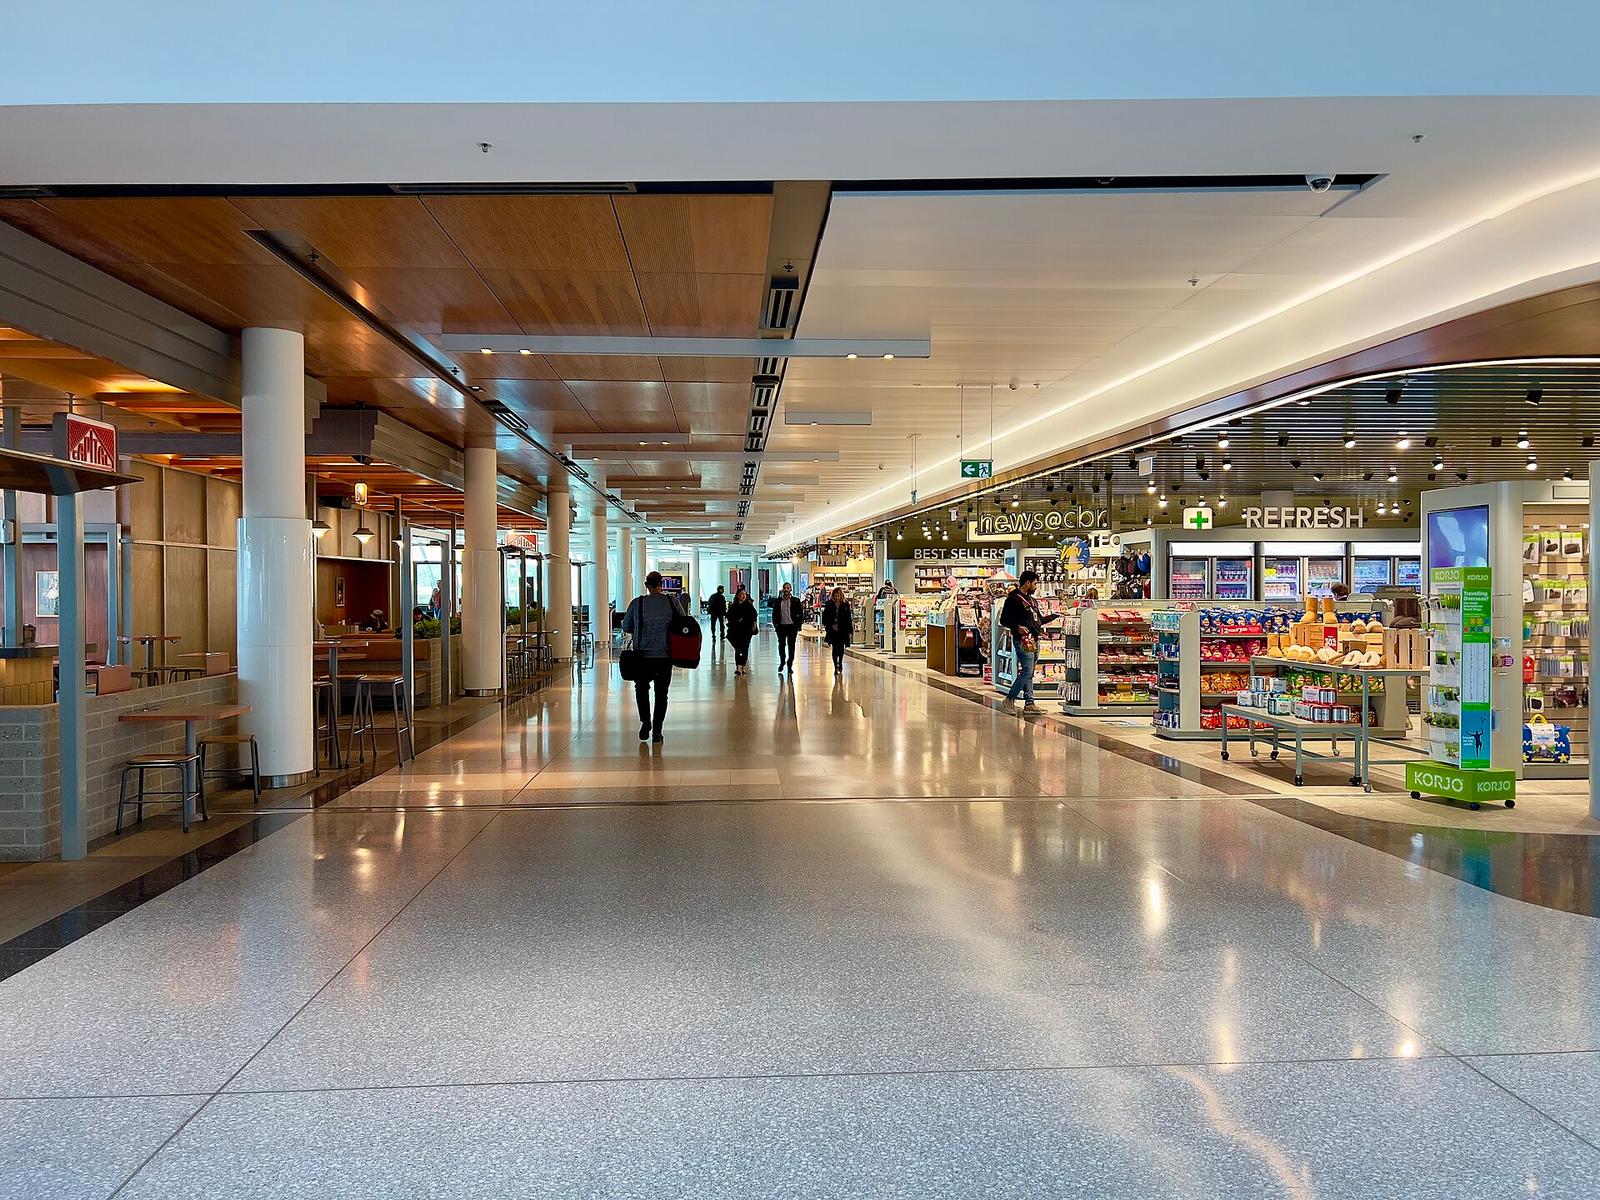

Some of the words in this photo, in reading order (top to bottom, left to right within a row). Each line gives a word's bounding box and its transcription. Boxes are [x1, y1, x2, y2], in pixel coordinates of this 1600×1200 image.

[1246, 506, 1363, 528] REFRESH
[914, 548, 947, 559] BEST
[950, 548, 1005, 559] SELLERS
[1435, 570, 1460, 580] KORJO
[1414, 771, 1464, 792] KORJO
[1477, 780, 1512, 792] KORJO
